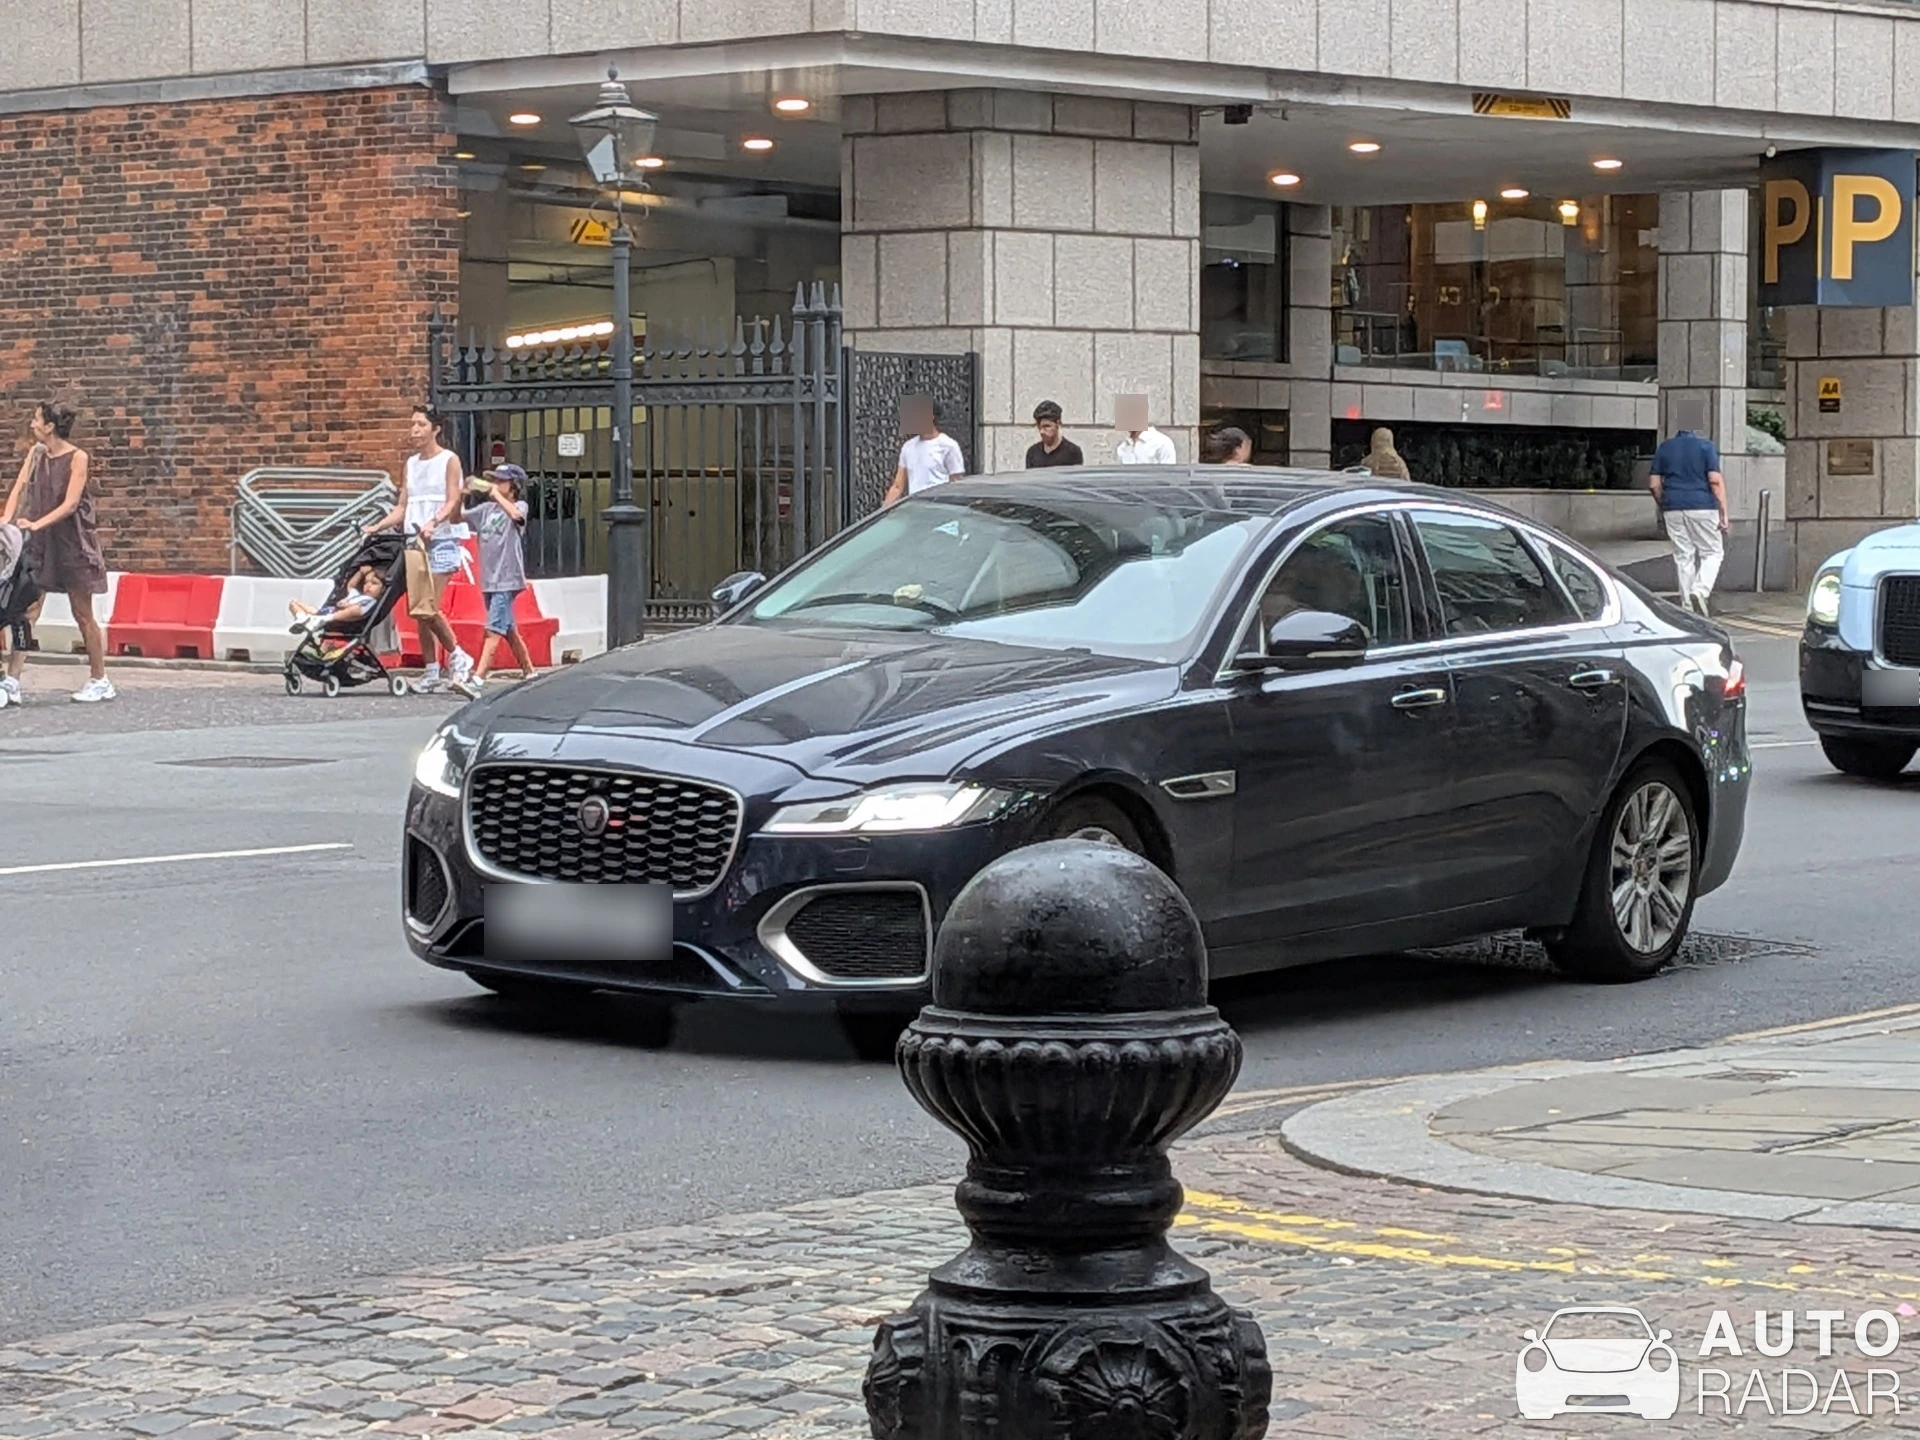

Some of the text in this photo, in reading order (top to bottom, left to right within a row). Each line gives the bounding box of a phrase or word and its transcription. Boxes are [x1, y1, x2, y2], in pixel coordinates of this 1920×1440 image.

[1765, 179, 1810, 283] P
[1831, 174, 1901, 280] P
[1821, 382, 1839, 395] AA
